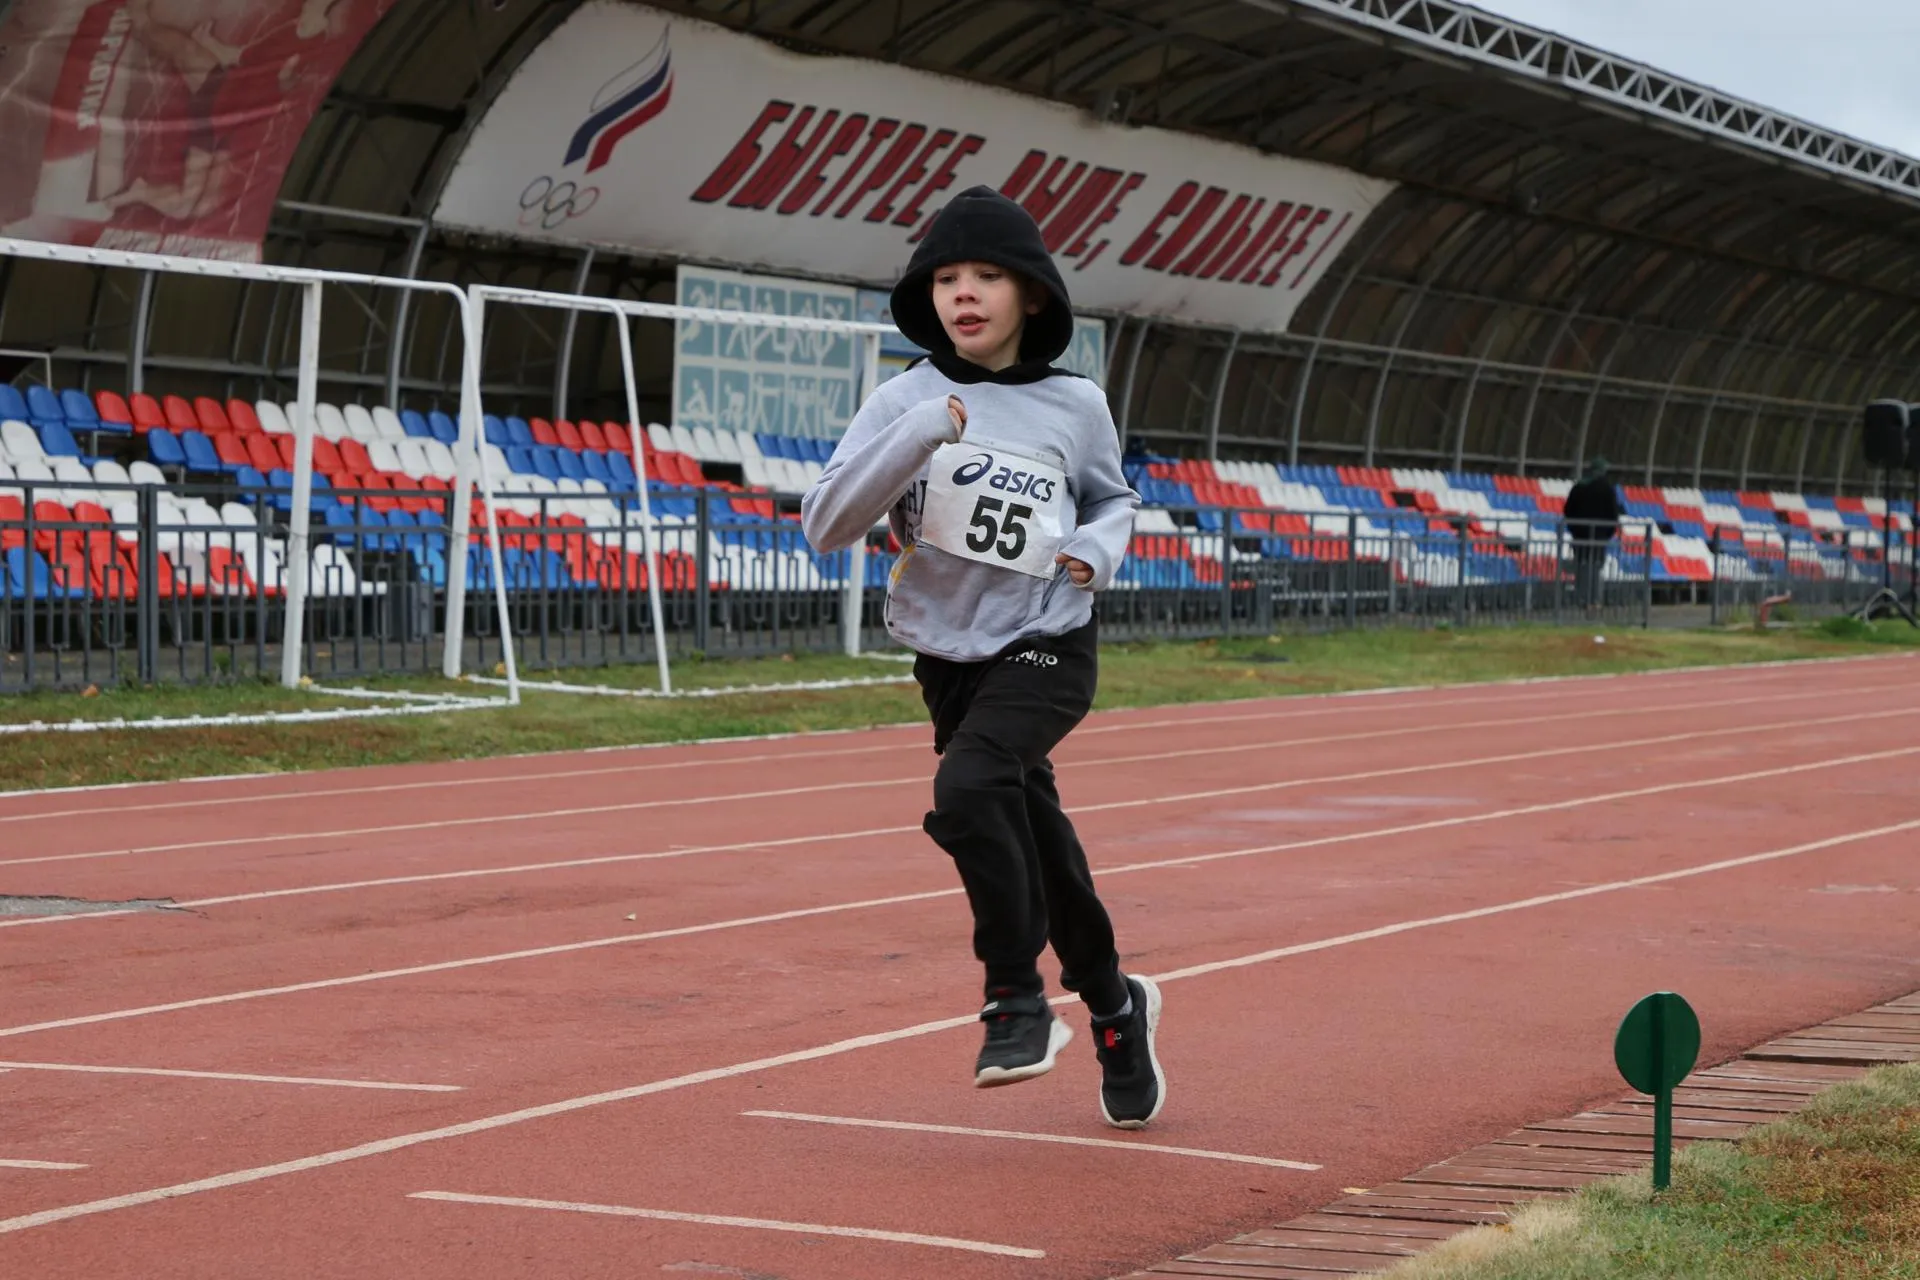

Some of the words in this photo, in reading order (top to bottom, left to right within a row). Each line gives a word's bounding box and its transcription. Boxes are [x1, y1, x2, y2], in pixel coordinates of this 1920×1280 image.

[690, 99, 987, 243] БЫСТРЕЕ,
[1119, 180, 1353, 290] СИЛЬНЕЕ!
[988, 466, 1056, 503] asics
[965, 494, 1033, 561] 55
